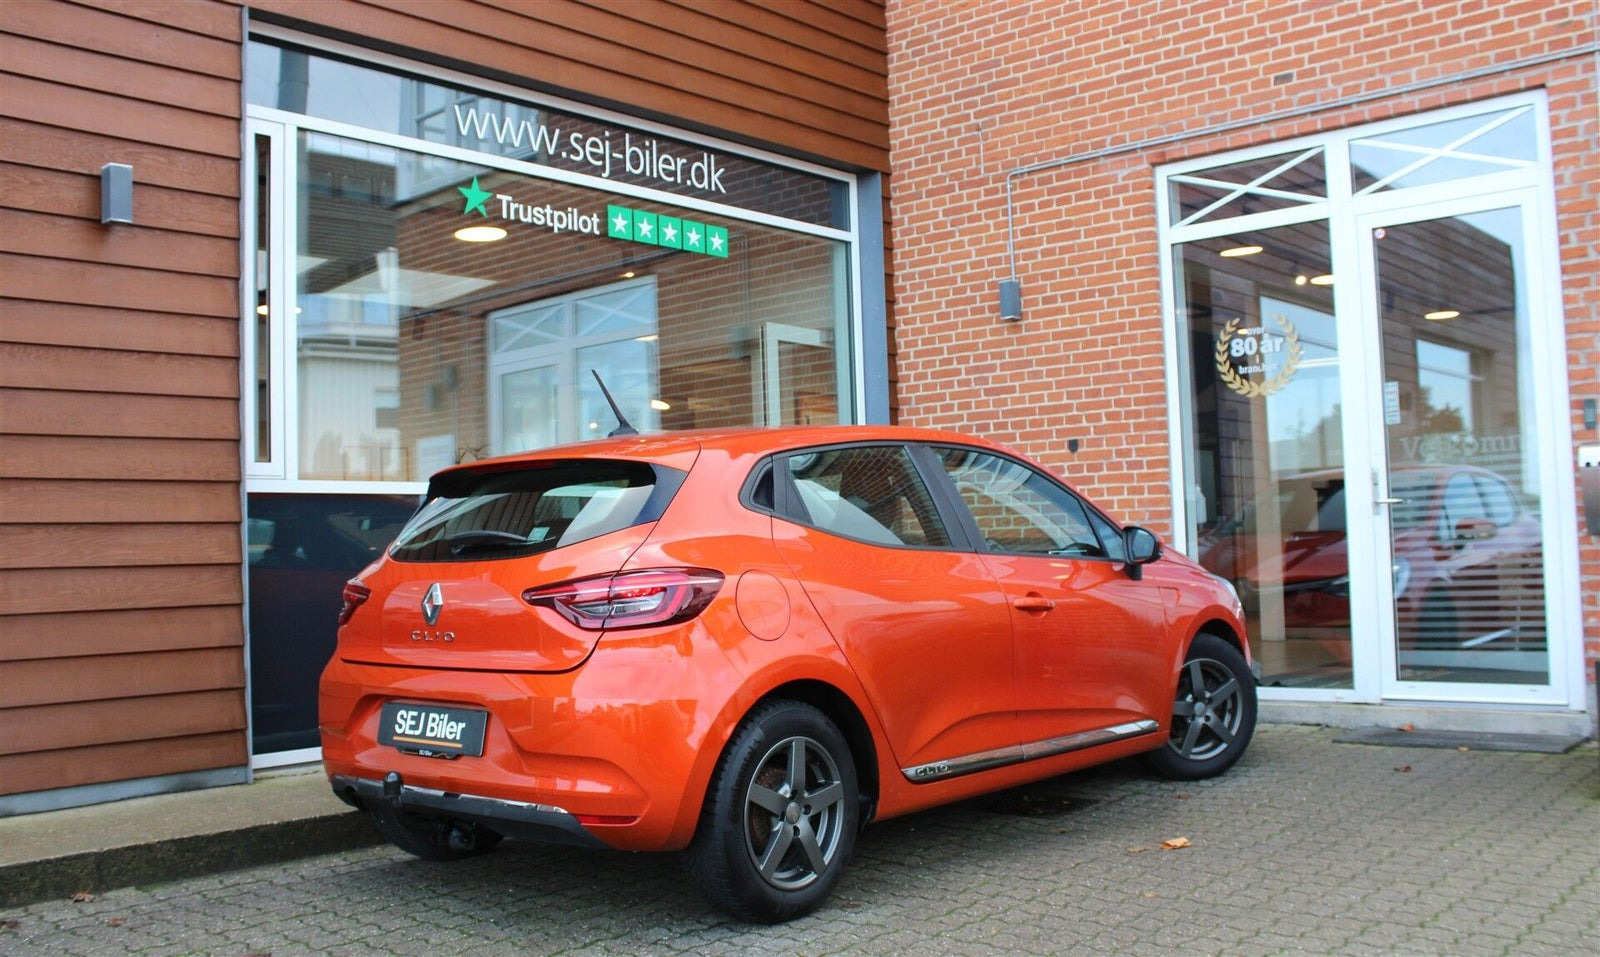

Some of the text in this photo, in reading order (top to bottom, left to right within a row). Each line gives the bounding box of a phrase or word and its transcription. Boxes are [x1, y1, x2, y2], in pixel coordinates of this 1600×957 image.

[454, 104, 727, 194] www.sej-biler.dk
[496, 193, 600, 235] Trustpilot
[1230, 333, 1283, 357] 80 år
[411, 630, 455, 641] CLIO
[394, 709, 466, 740] SEJ Biler
[915, 764, 948, 776] CLIO
